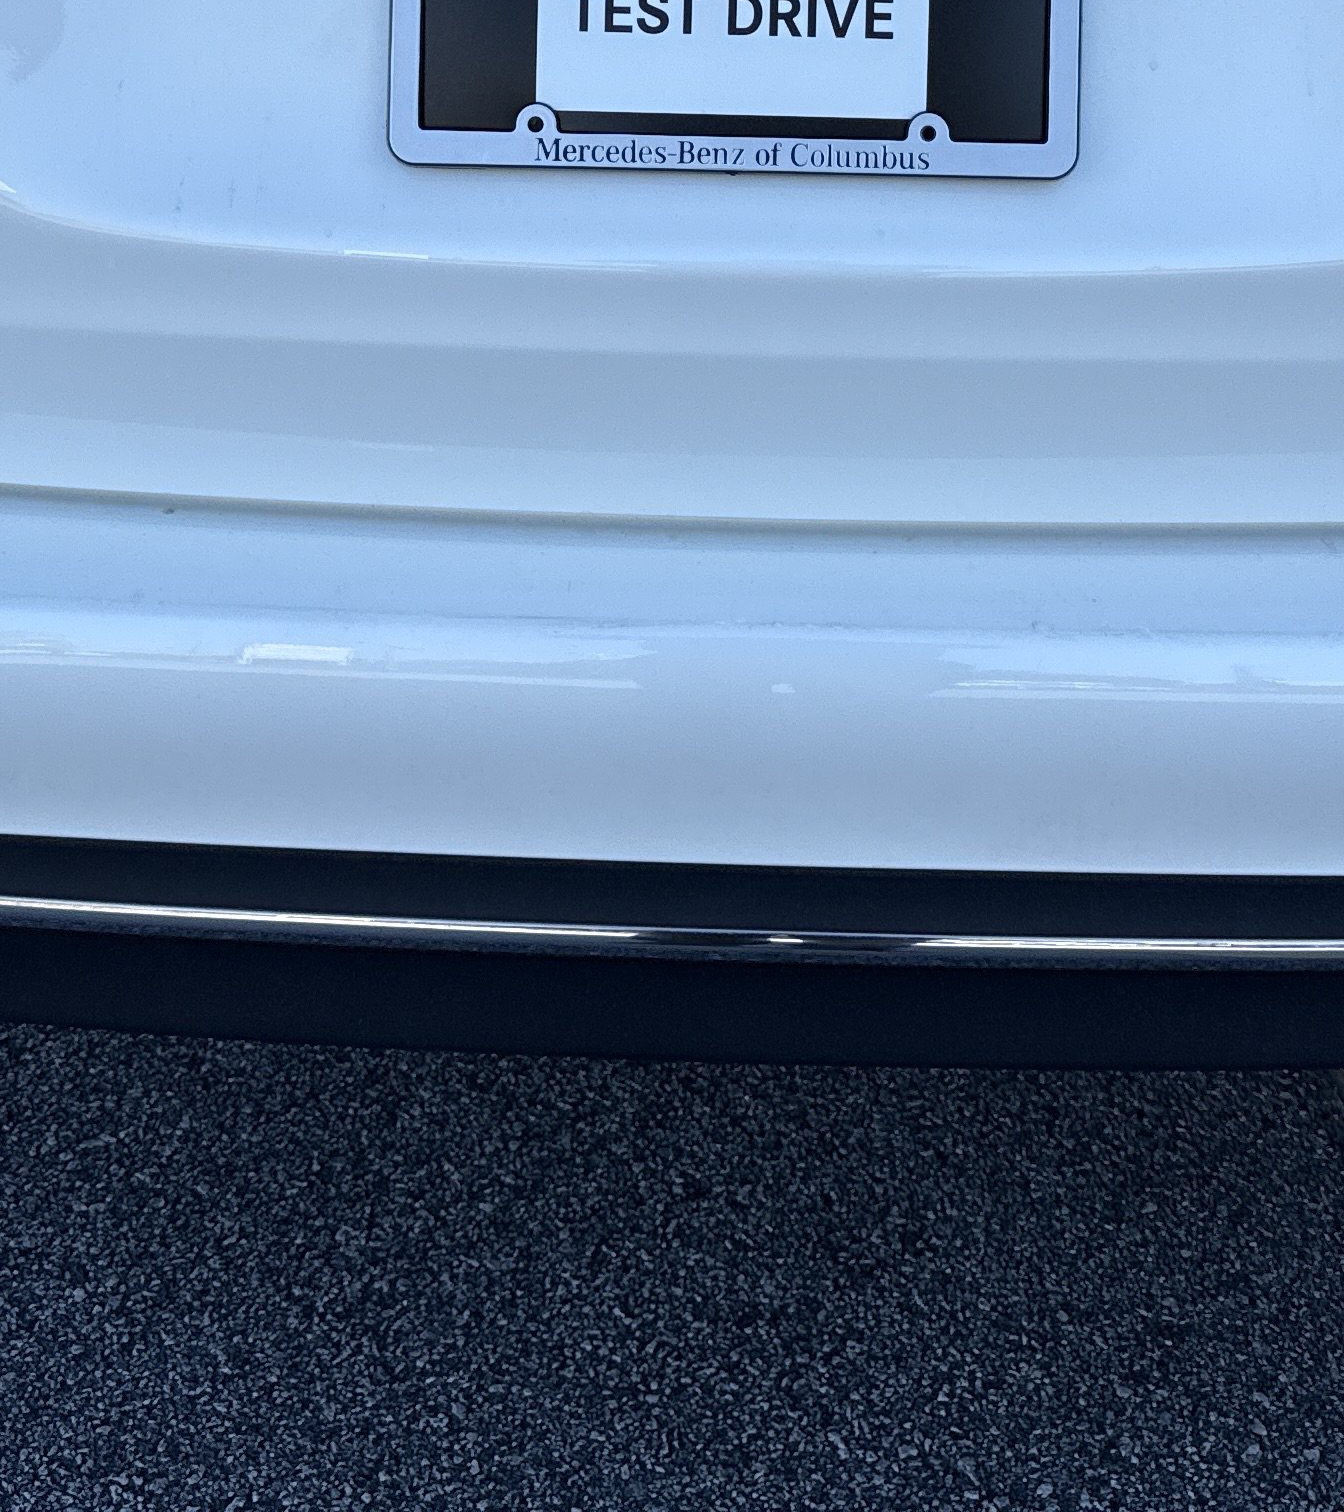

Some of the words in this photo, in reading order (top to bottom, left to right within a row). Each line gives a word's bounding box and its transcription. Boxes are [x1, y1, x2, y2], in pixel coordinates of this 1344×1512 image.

[535, 137, 746, 166] Mercedes-Benz
[755, 142, 783, 168] of
[790, 143, 930, 170] Columbus
